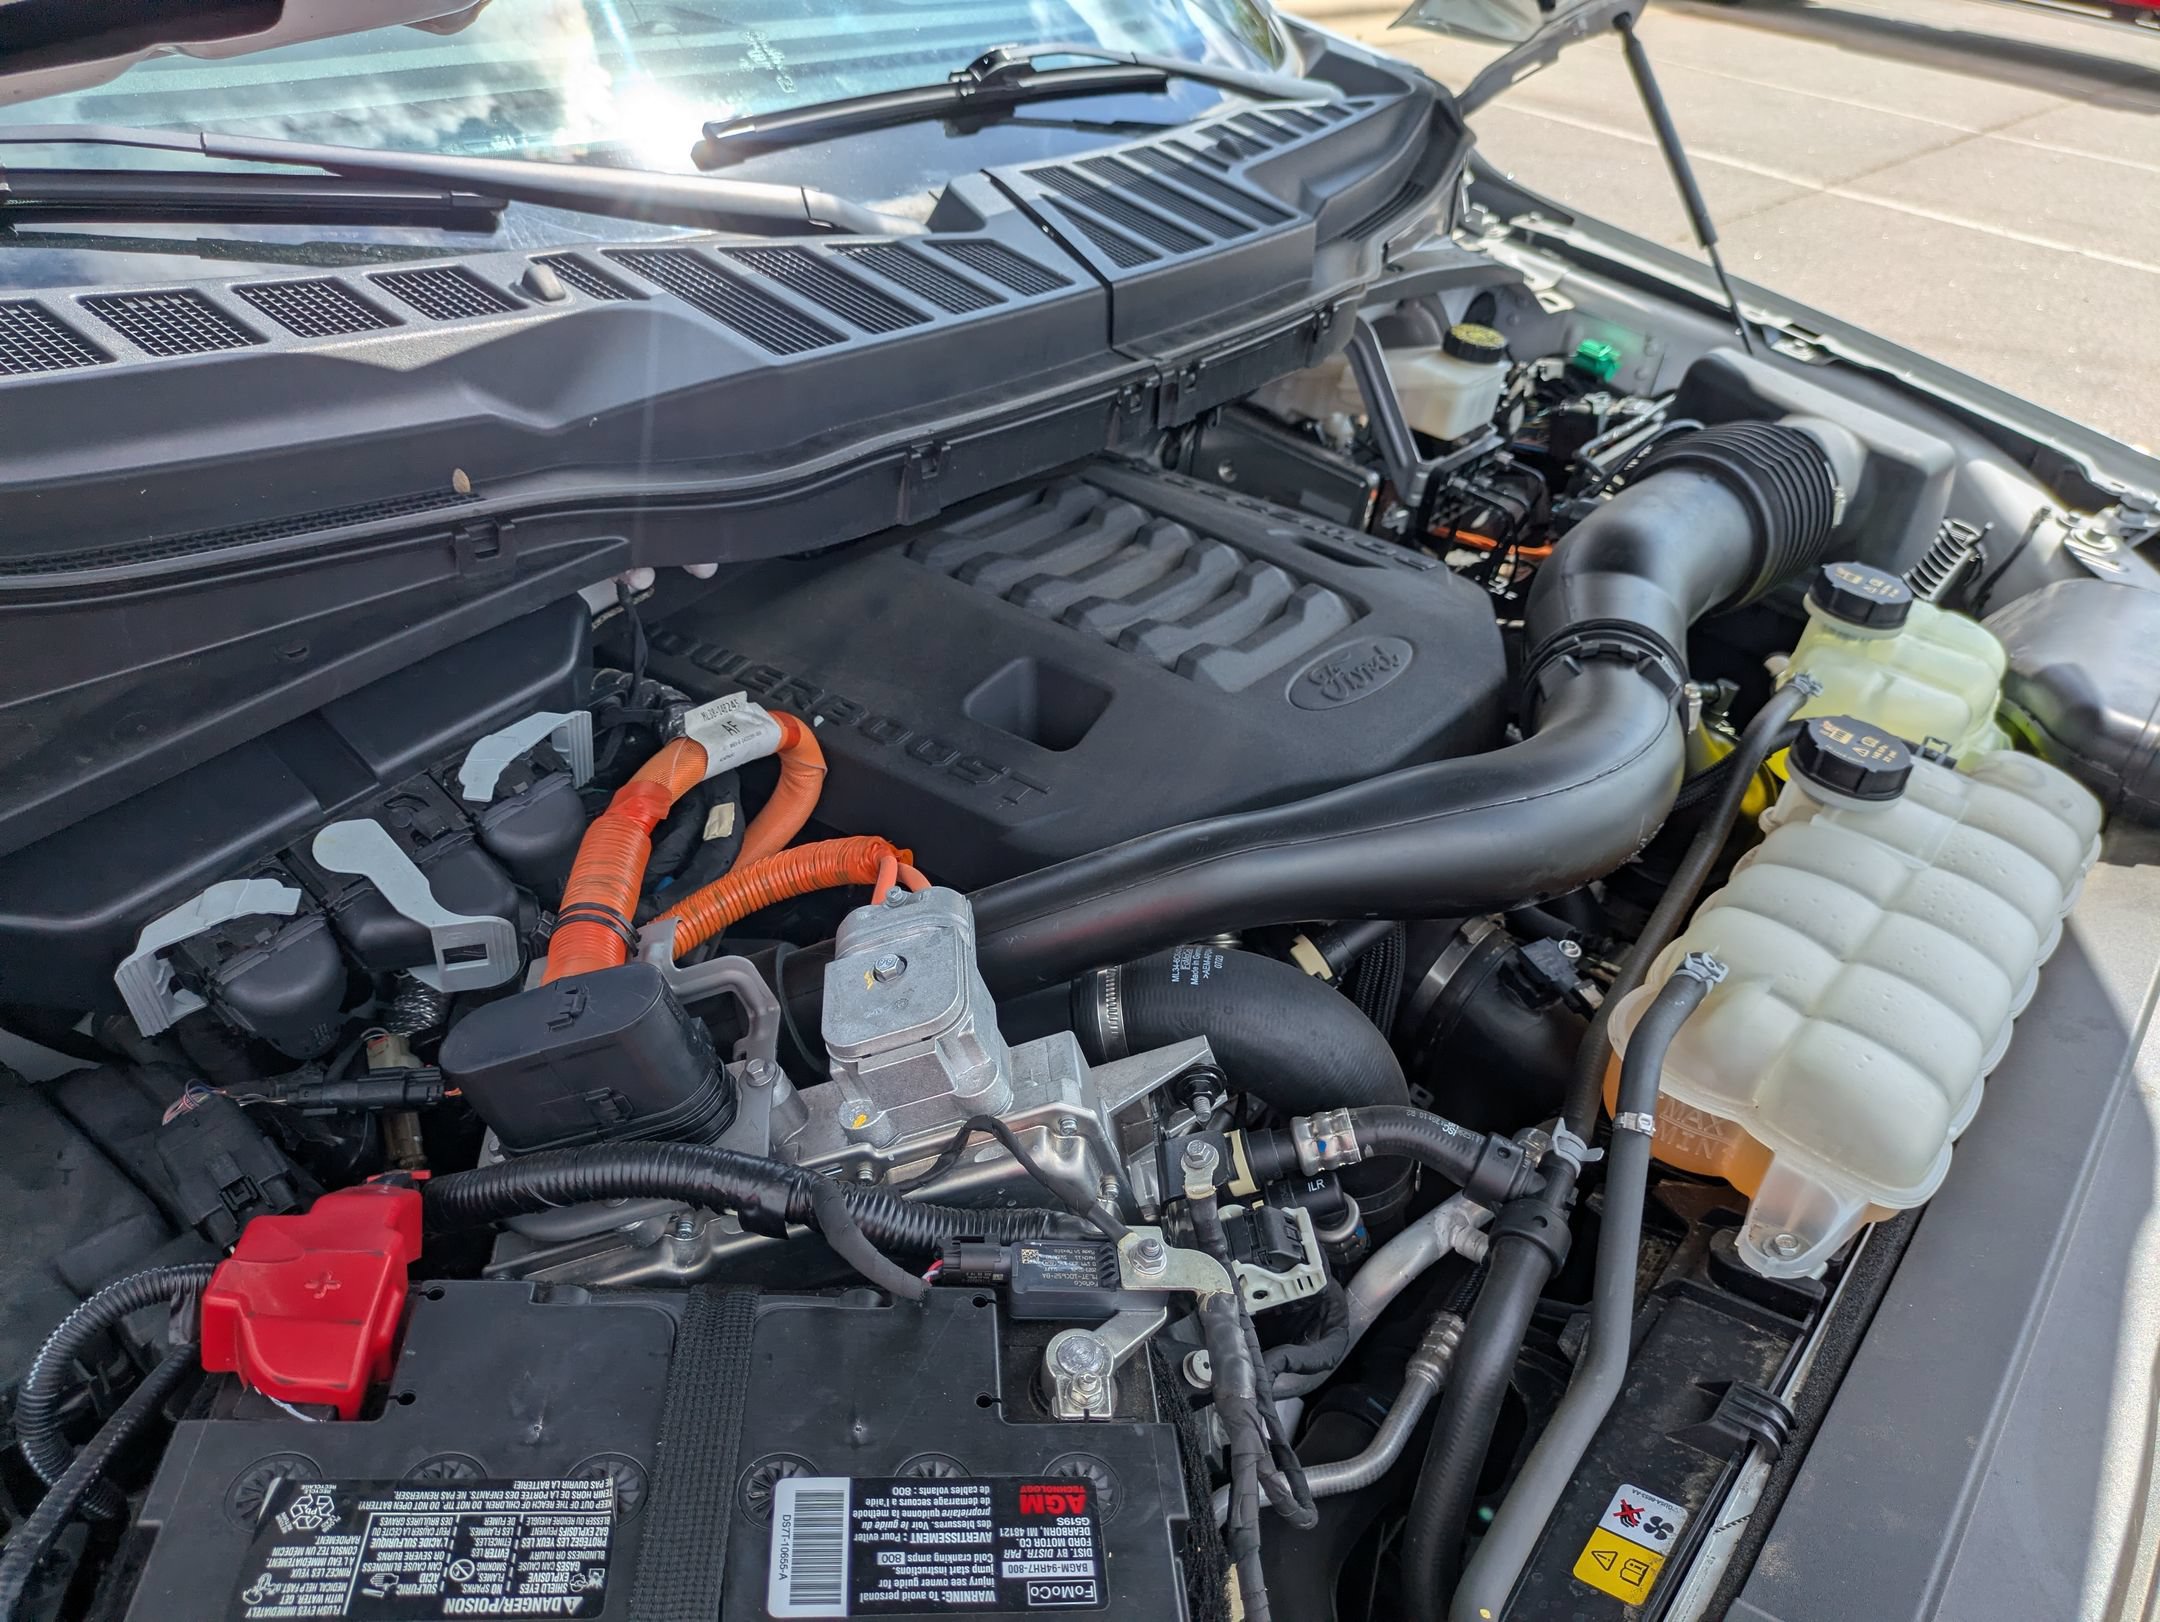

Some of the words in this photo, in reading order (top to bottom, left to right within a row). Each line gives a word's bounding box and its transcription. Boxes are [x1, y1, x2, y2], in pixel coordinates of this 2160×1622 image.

[1307, 644, 1402, 701] Ford
[722, 720, 741, 736] AF
[1190, 966, 1199, 986] Made
[1663, 1100, 1723, 1137] MAX
[1660, 1121, 1720, 1159] MIN
[1307, 1179, 1326, 1192] ILR
[394, 1491, 439, 1500] RENVERSER.
[439, 1489, 455, 1499] PAS
[457, 1489, 467, 1499] NE
[469, 1489, 504, 1499] ENFANTS.
[506, 1489, 519, 1499] DES
[550, 1489, 559, 1499] LA
[561, 1489, 570, 1499] DE
[572, 1489, 591, 1499] HORS
[593, 1489, 612, 1499] TENIR
[358, 1500, 392, 1509] BATTERY!
[394, 1500, 412, 1509] OPEN
[414, 1500, 428, 1509] NOT
[430, 1500, 440, 1509] DO
[442, 1500, 454, 1509] TIP.
[456, 1500, 471, 1509] NOT
[472, 1500, 482, 1509] DO
[485, 1500, 520, 1509] CHILDREN.
[522, 1500, 531, 1509] OF
[532, 1500, 555, 1509] REACH
[557, 1500, 568, 1509] THE
[570, 1500, 581, 1509] OF
[583, 1500, 594, 1509] OUT
[595, 1500, 611, 1509] KEEP
[1019, 1495, 1086, 1514] AGM
[862, 1521, 873, 1530] du
[875, 1520, 898, 1530] guide
[900, 1522, 909, 1530] le
[912, 1521, 929, 1530] Voir
[932, 1520, 975, 1530] blessures.
[977, 1520, 991, 1530] des
[1057, 1517, 1089, 1525] G519S
[999, 1528, 1024, 1536] 48121
[1028, 1528, 1037, 1536] MI
[1040, 1526, 1090, 1536] DEARBORN,
[314, 1535, 361, 1544] RAPIDEMENT.
[854, 1533, 878, 1541] eviter
[881, 1533, 900, 1541] Pour
[910, 1532, 992, 1543] AVERTISSEMENT
[1068, 1537, 1091, 1547] FORD
[778, 1514, 792, 1581] DS7T-10655-A
[1016, 1539, 1032, 1547] CO.
[1034, 1538, 1065, 1547] MOTOR
[377, 1551, 403, 1560] BURNS
[405, 1551, 432, 1560] SEVERE
[435, 1551, 445, 1560] OR
[529, 1551, 554, 1560] INJURY
[556, 1551, 566, 1560] OR
[568, 1551, 605, 1560] BLINDNESS
[934, 1552, 971, 1563] cranking
[1003, 1549, 1022, 1558] PAR
[1024, 1549, 1053, 1558] DISTR.
[1057, 1549, 1068, 1558] BY
[1070, 1548, 1092, 1557] DIST.
[882, 1554, 902, 1563] 800
[908, 1553, 932, 1563] amps
[974, 1554, 993, 1563] Cold
[362, 1562, 402, 1572] BLINDNESS
[403, 1562, 426, 1572] CAUSE
[428, 1562, 442, 1572] CAN
[477, 1561, 507, 1571] SMOKING
[518, 1561, 540, 1571] CAUSE
[542, 1561, 555, 1571] CAN
[557, 1561, 580, 1571] GASES
[892, 1566, 947, 1575] instructions.
[949, 1566, 969, 1575] start
[972, 1564, 994, 1574] jump
[290, 1569, 310, 1577] YEUX
[312, 1567, 323, 1577] LES
[326, 1567, 352, 1577] RINCEZ
[528, 1572, 569, 1582] EXPLOSIVE
[419, 1573, 440, 1583] ACID
[894, 1577, 918, 1588] guide
[969, 1577, 994, 1587] injury
[281, 1583, 298, 1592] FAST.
[299, 1582, 317, 1592] HELP
[318, 1582, 348, 1592] MEDICAL
[395, 1584, 437, 1594] SULFURIC
[461, 1583, 490, 1593] SPARKS,
[491, 1583, 502, 1593] NO
[520, 1583, 539, 1593] EYES
[541, 1583, 568, 1593] SHIELD
[878, 1580, 891, 1588] for
[859, 1592, 899, 1602] personal
[902, 1592, 926, 1601] avoid
[928, 1591, 939, 1601] To
[942, 1591, 995, 1601] WARNING:
[1030, 1585, 1094, 1599] FoMoCo
[279, 1595, 294, 1604] GET
[297, 1594, 322, 1604] WATER.
[324, 1594, 344, 1604] WITH
[317, 1605, 341, 1615] FLUSH
[443, 1597, 561, 1613] DANGER/POISON
[245, 1606, 296, 1617] IMMEDIATELY
[298, 1606, 316, 1616] EYES
